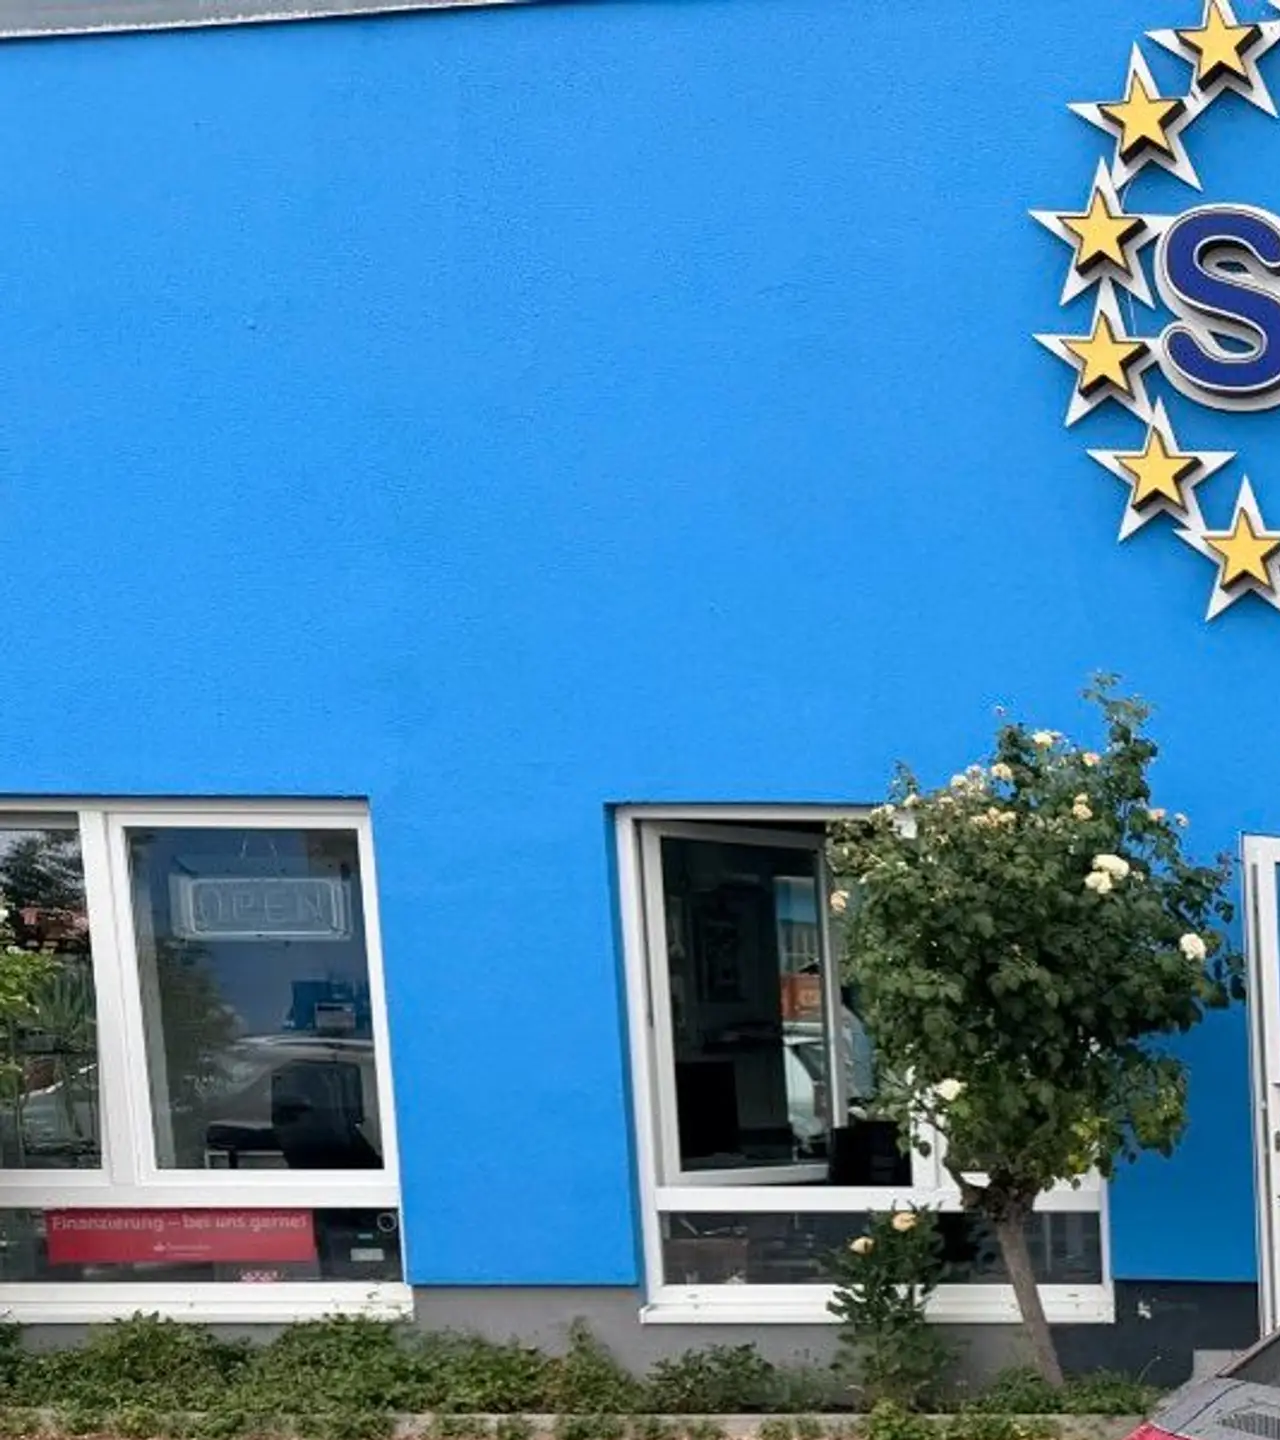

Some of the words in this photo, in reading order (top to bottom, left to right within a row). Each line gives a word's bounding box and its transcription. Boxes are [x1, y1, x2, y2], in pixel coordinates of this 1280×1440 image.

[52, 1215, 165, 1231] Finanzierung
[183, 1214, 210, 1228] bei
[216, 1215, 246, 1228] uns
